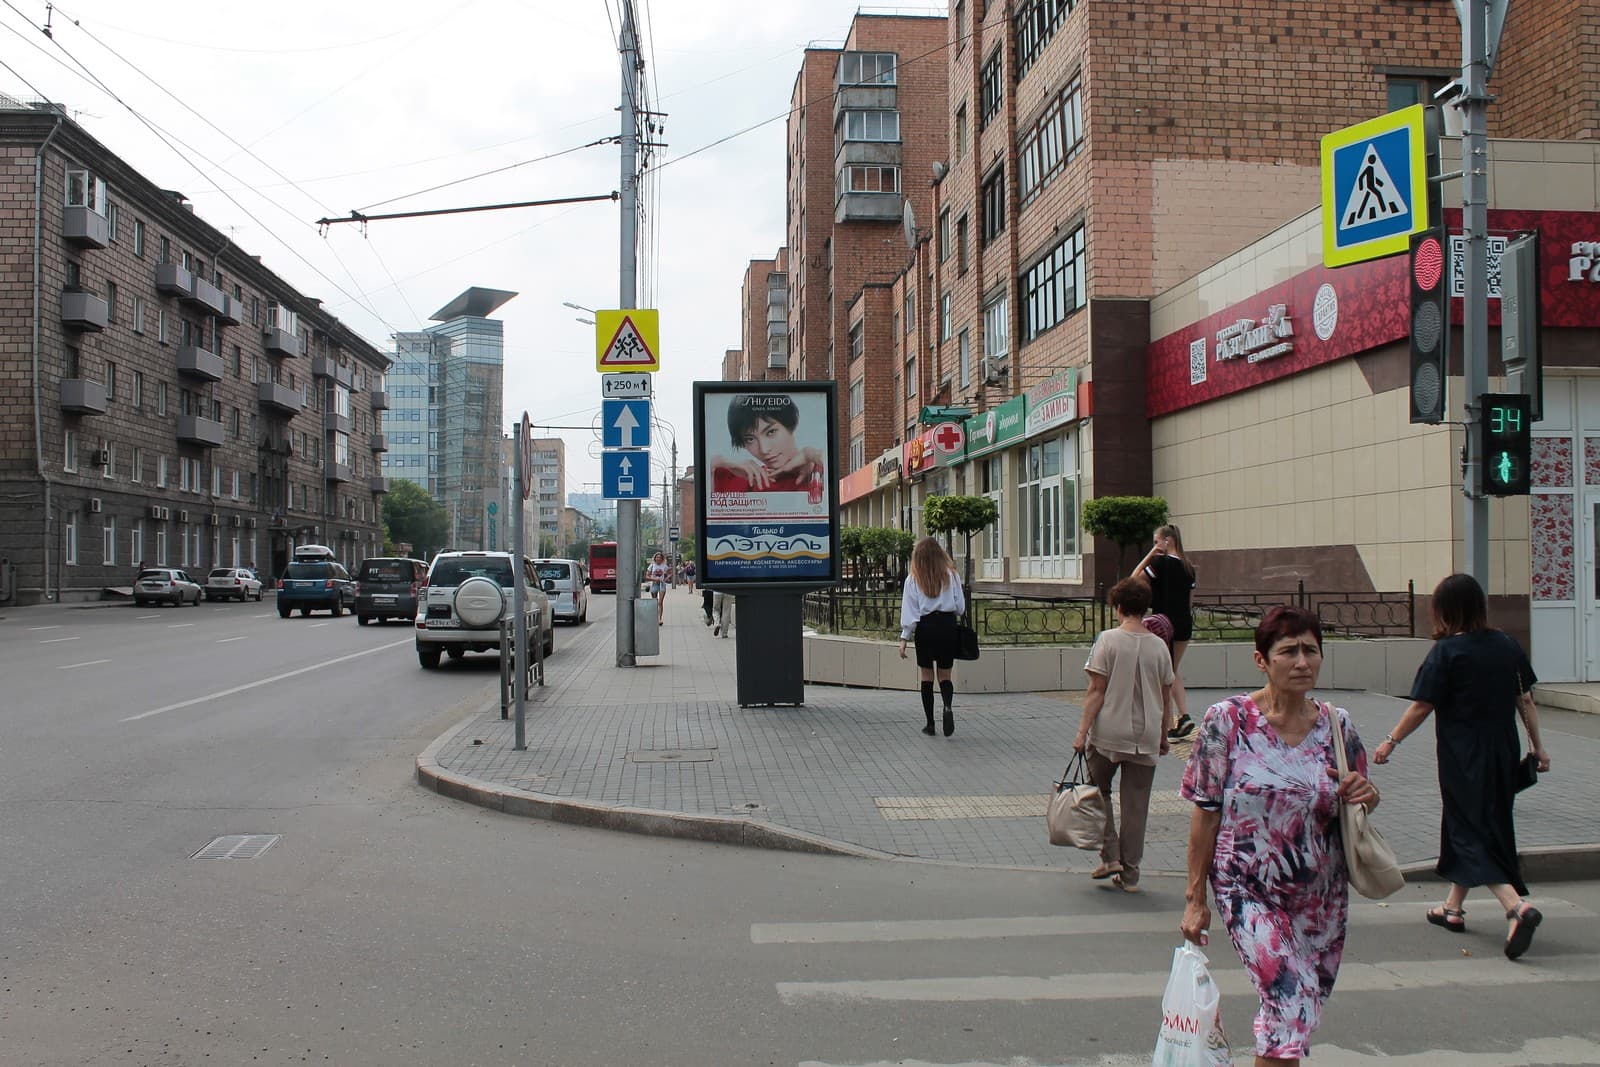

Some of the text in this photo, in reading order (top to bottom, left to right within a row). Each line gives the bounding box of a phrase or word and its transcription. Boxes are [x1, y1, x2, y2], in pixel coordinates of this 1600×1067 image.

[614, 380, 631, 390] 250
[741, 396, 791, 406] SHISEIDO
[1491, 407, 1520, 432] 34
[711, 498, 767, 507] ПОД ЗАЩИТОЙ
[752, 526, 784, 534] Только в
